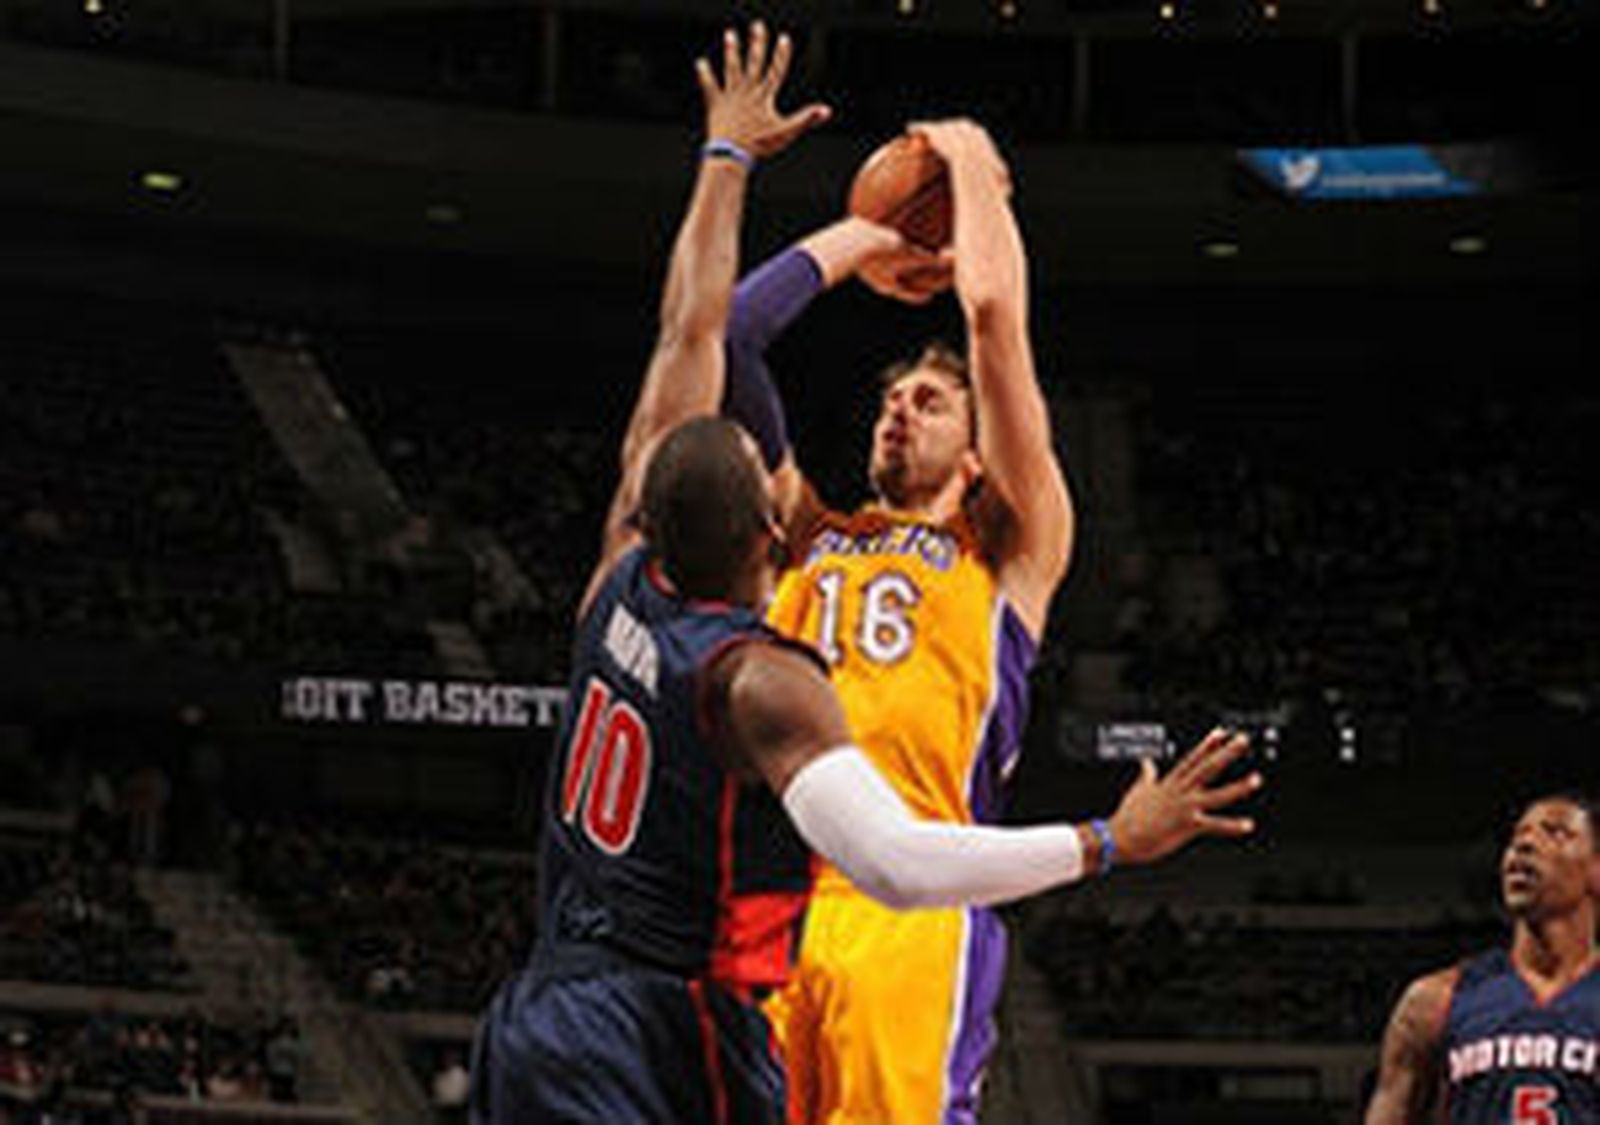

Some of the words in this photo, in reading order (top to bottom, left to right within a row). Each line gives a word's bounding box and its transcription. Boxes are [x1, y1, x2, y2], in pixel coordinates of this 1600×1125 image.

[820, 572, 921, 663] 16
[563, 676, 652, 854] 10
[1511, 1084, 1559, 1125] 5
